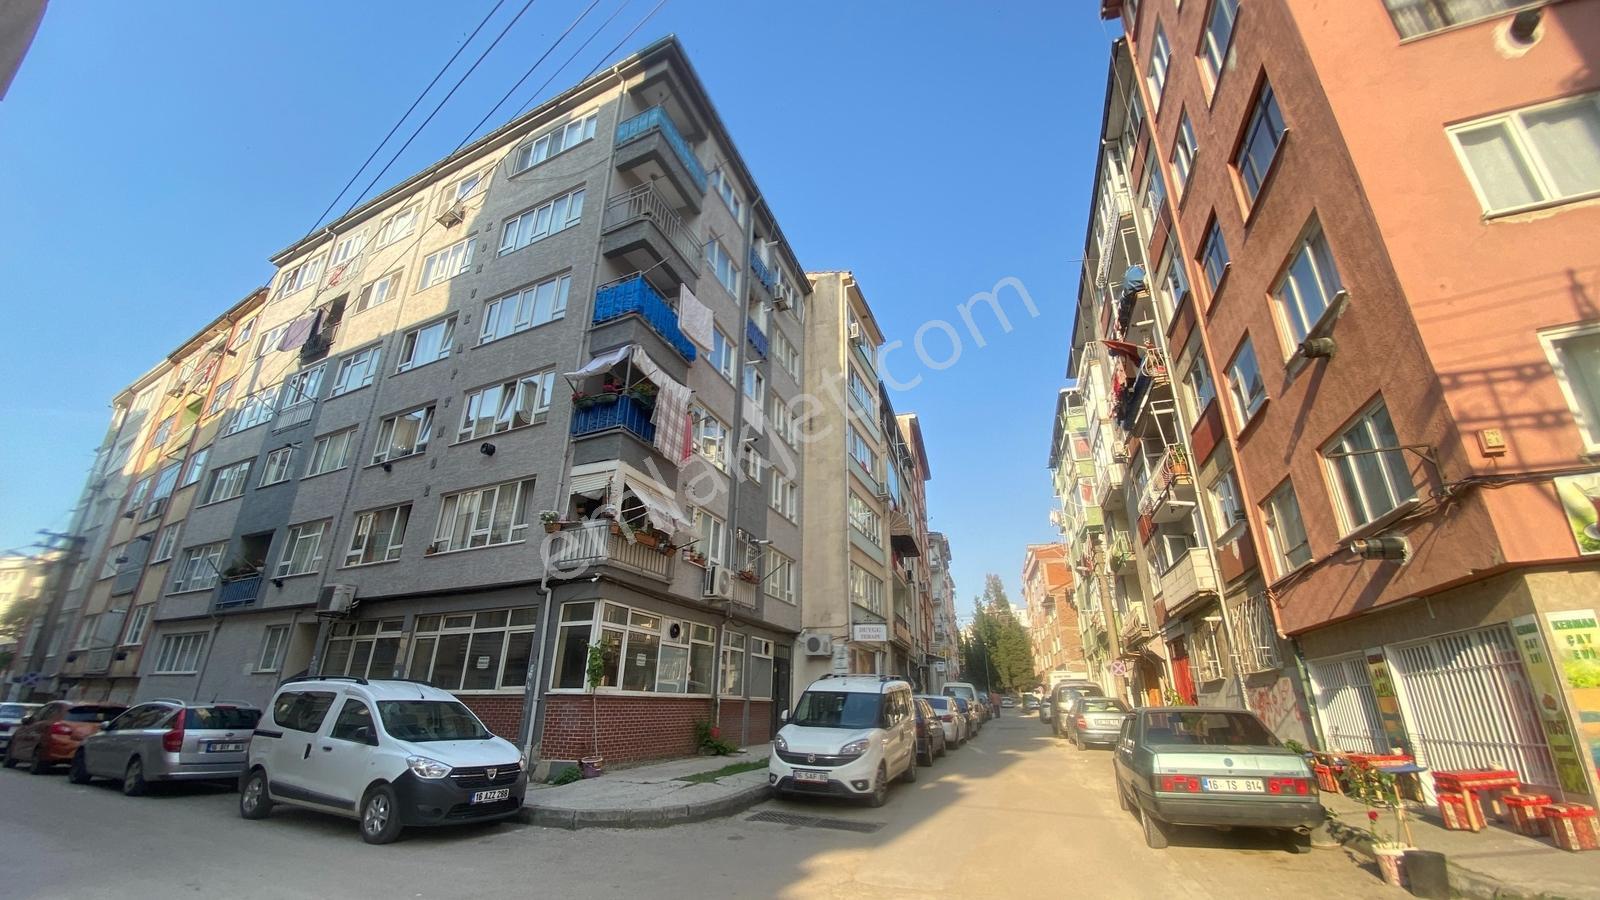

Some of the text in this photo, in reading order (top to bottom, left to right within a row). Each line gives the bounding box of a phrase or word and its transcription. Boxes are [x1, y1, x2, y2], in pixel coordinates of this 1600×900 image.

[1551, 617, 1598, 631] KERMAN
[1566, 633, 1593, 647] ÇAY
[1208, 780, 1262, 791] 16 TS 814
[476, 792, 483, 801] 16
